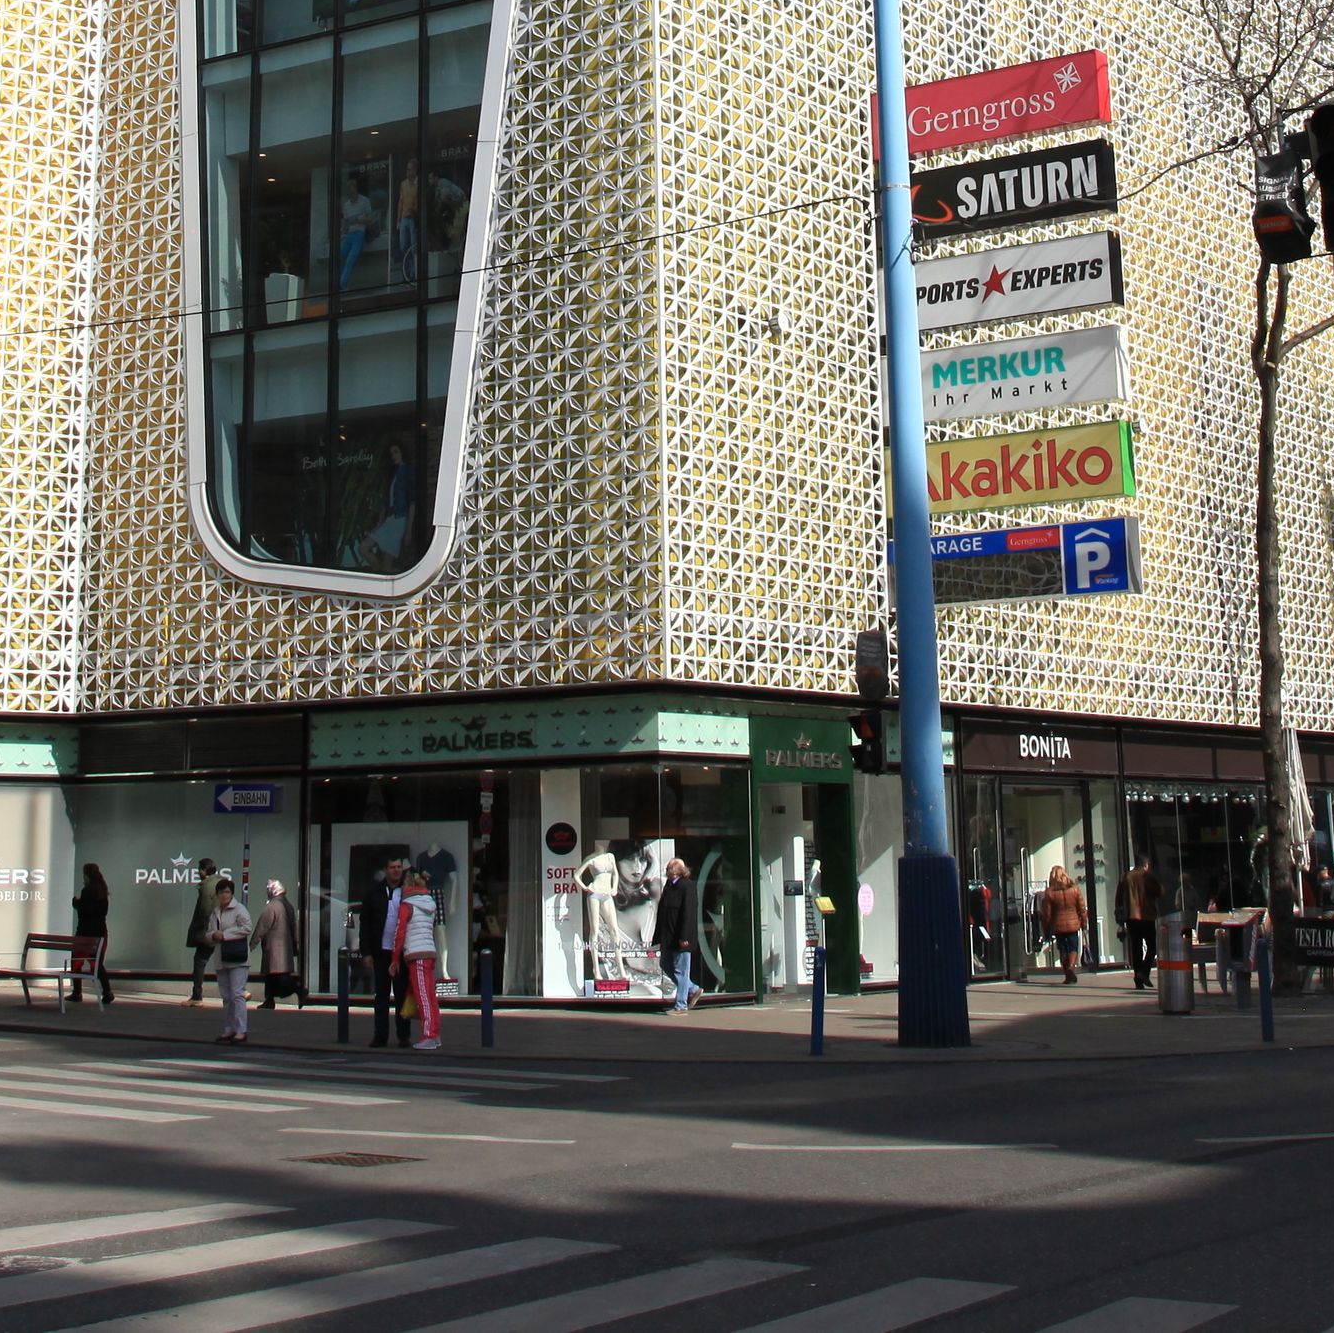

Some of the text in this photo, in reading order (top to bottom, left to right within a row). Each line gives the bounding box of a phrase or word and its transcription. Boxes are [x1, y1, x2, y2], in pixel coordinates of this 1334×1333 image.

[908, 91, 1056, 136] Gerngross
[956, 154, 1099, 219] SATURN
[916, 258, 1104, 307] PORTS EXPERTS
[932, 346, 1067, 389] MERKUR
[932, 378, 1068, 407] Ihr Markt
[1074, 541, 1111, 589] P
[422, 730, 535, 754] PALMERS
[1019, 732, 1072, 765] BONITA
[765, 749, 843, 770] PALMERS
[233, 792, 268, 805] EINBAHN
[136, 867, 233, 884] PALMES
[547, 867, 577, 880] SOFT
[20, 890, 45, 902] DIR.
[554, 883, 578, 894] BRA
[1295, 928, 1322, 947] TESTA
